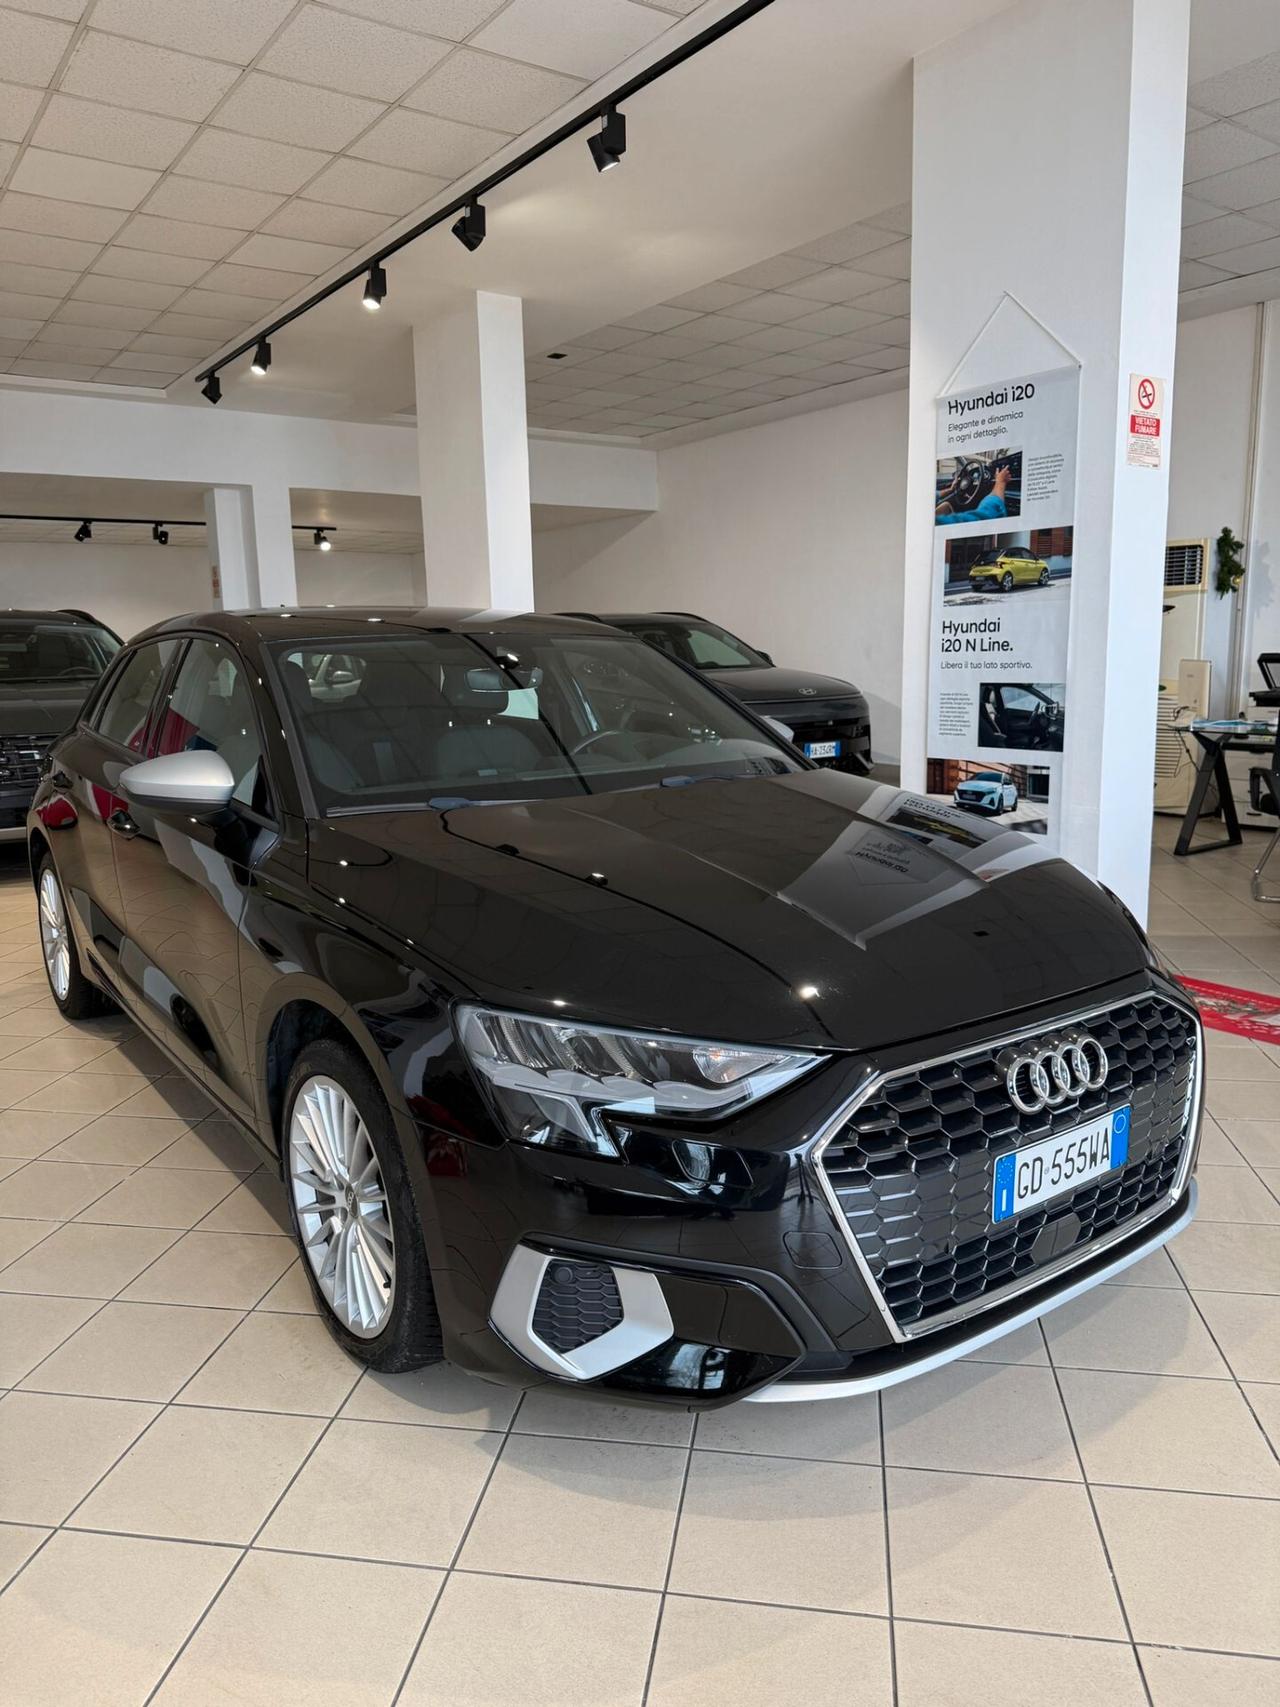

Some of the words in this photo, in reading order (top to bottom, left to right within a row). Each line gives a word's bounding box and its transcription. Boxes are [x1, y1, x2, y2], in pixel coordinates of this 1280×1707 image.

[948, 388, 1008, 416] Hyundai
[1011, 383, 1035, 402] i20
[948, 419, 979, 432] Elegante
[988, 411, 1024, 424] dinamica
[947, 435, 955, 443] in
[956, 431, 972, 443] ogni
[973, 426, 1009, 439] dettaglio.
[942, 617, 1001, 637] Hyundai
[941, 638, 962, 653] i20
[966, 638, 976, 652] N
[980, 637, 1014, 652] Line.
[940, 661, 963, 670] Libera
[964, 661, 969, 669] il
[970, 661, 982, 669] tuo
[983, 661, 998, 669] lato
[1000, 661, 1033, 671] sportivo.
[1017, 1156, 1043, 1200] GD
[1050, 1127, 1110, 1186] 555WA
